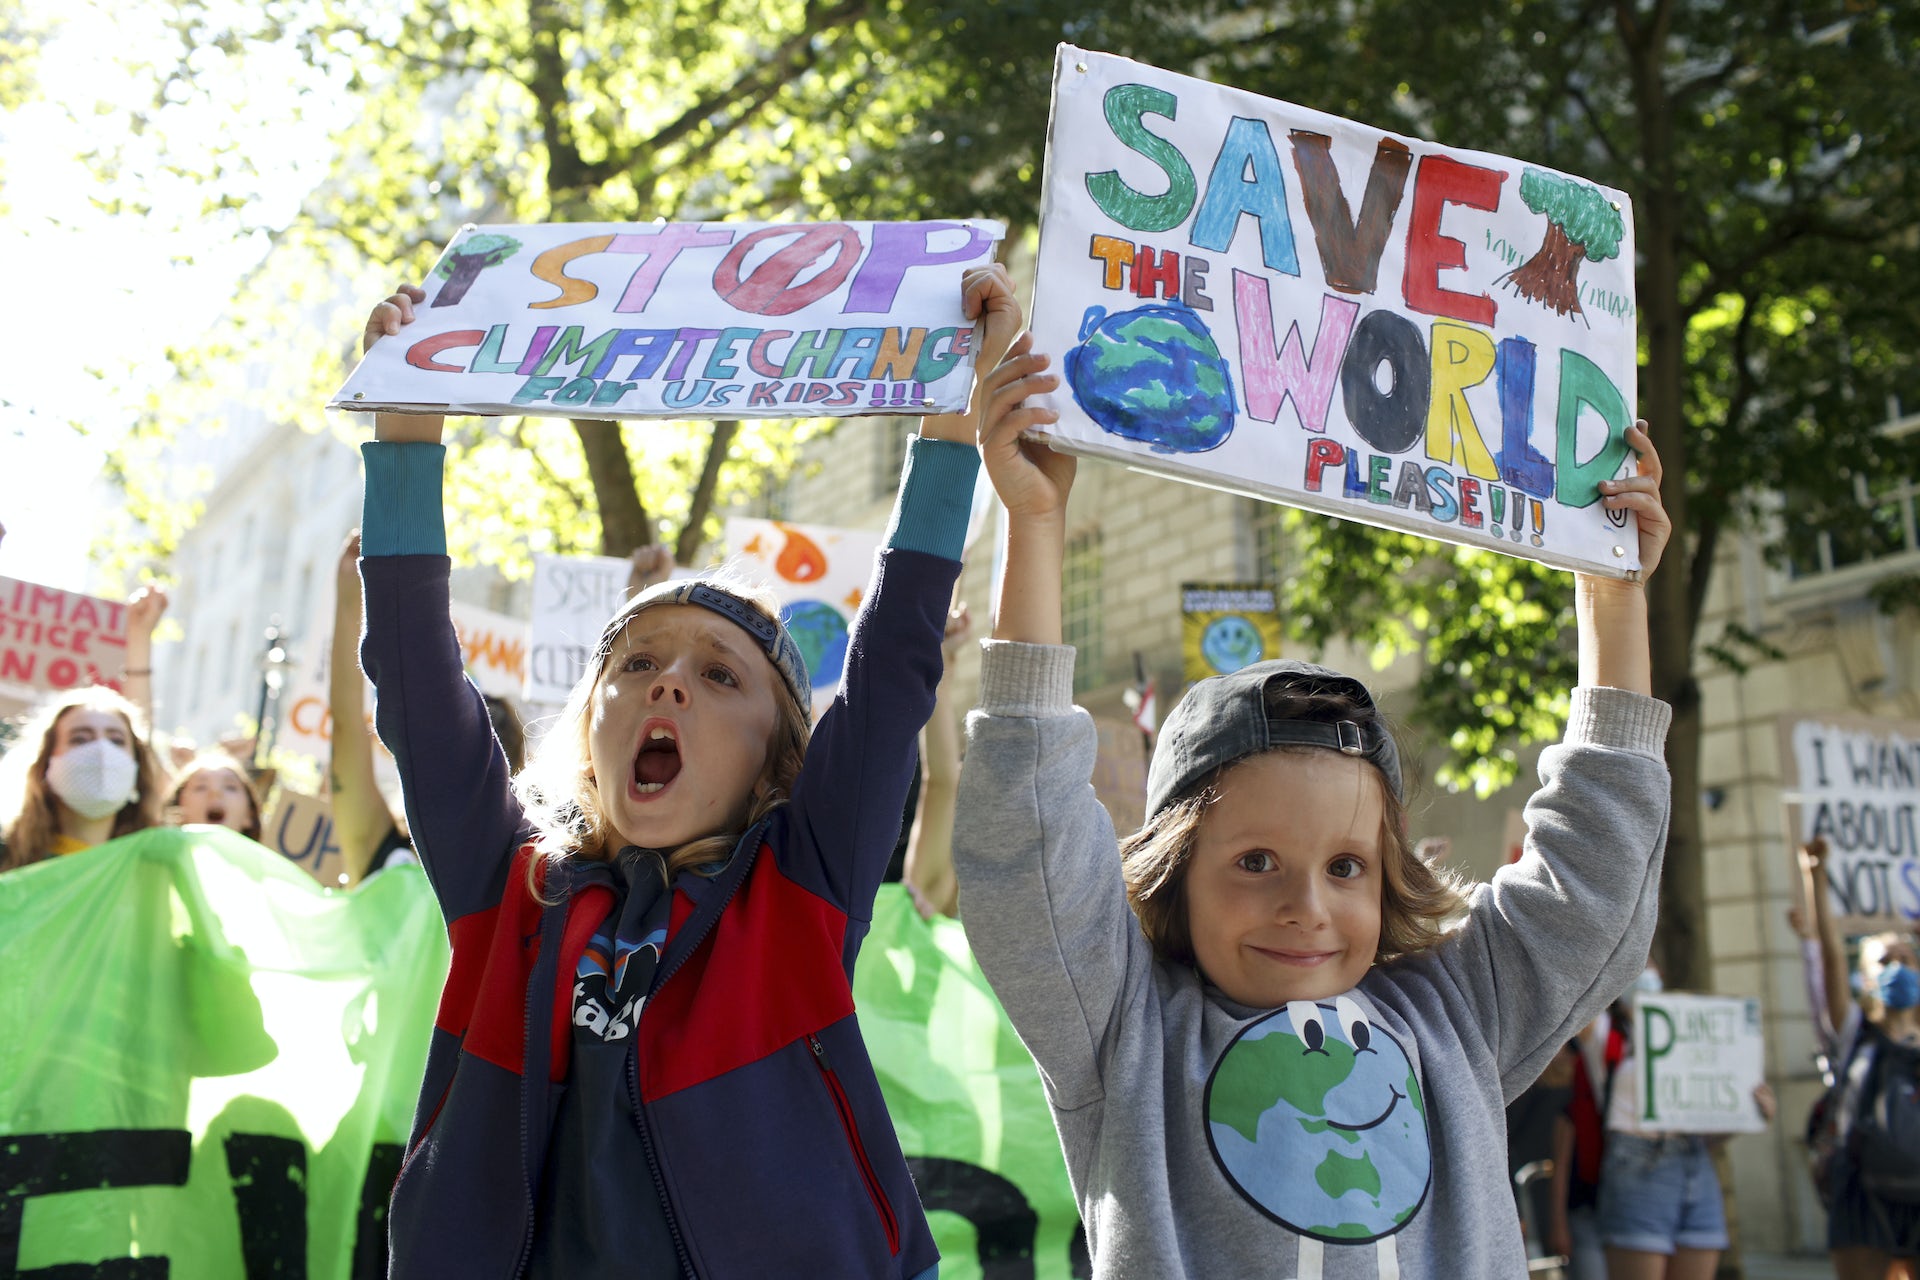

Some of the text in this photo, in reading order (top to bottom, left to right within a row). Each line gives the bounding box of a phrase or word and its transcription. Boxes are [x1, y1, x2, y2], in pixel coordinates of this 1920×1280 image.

[1085, 83, 1509, 330] SAVE
[528, 221, 992, 317] STOP
[1089, 234, 1214, 312] THE
[1232, 268, 1637, 509] WORLD
[0, 582, 125, 632] IMAT
[1812, 737, 1831, 787] I
[1813, 800, 1918, 857] ABOUT
[1824, 858, 1894, 919] NOT
